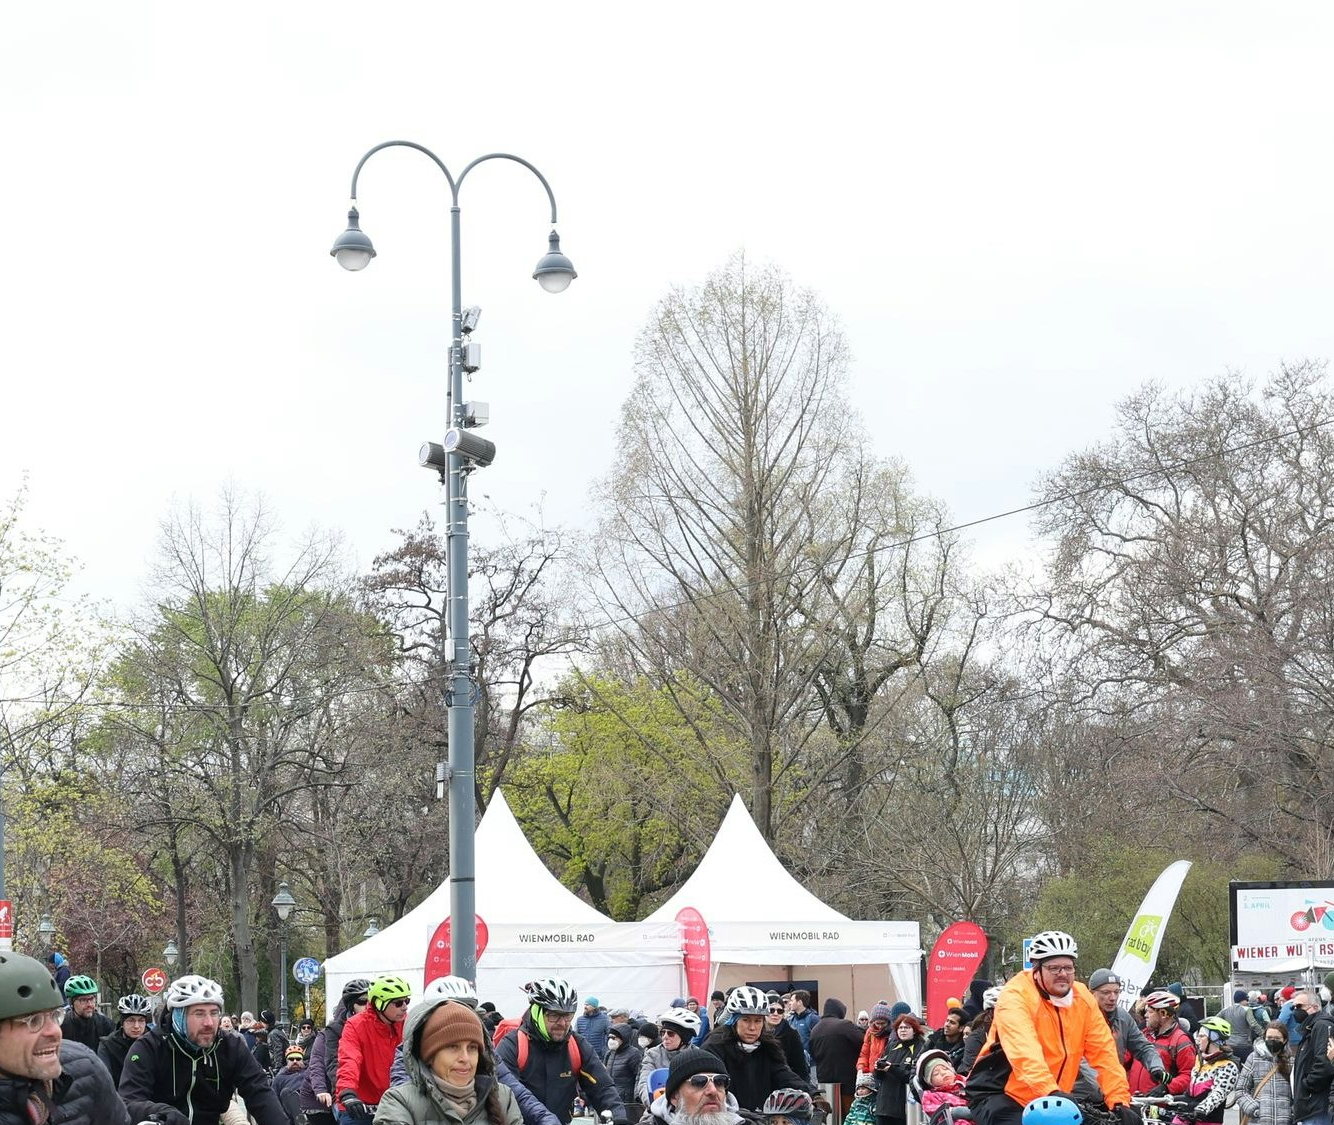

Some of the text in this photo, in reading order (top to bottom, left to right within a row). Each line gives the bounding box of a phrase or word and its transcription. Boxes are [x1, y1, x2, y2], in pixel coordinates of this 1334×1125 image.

[519, 934, 594, 943] WIENMOBIL RAD
[770, 932, 840, 940] WIENMOBIL RAD
[1237, 947, 1278, 958] WIENER
[1286, 944, 1303, 957] WU
